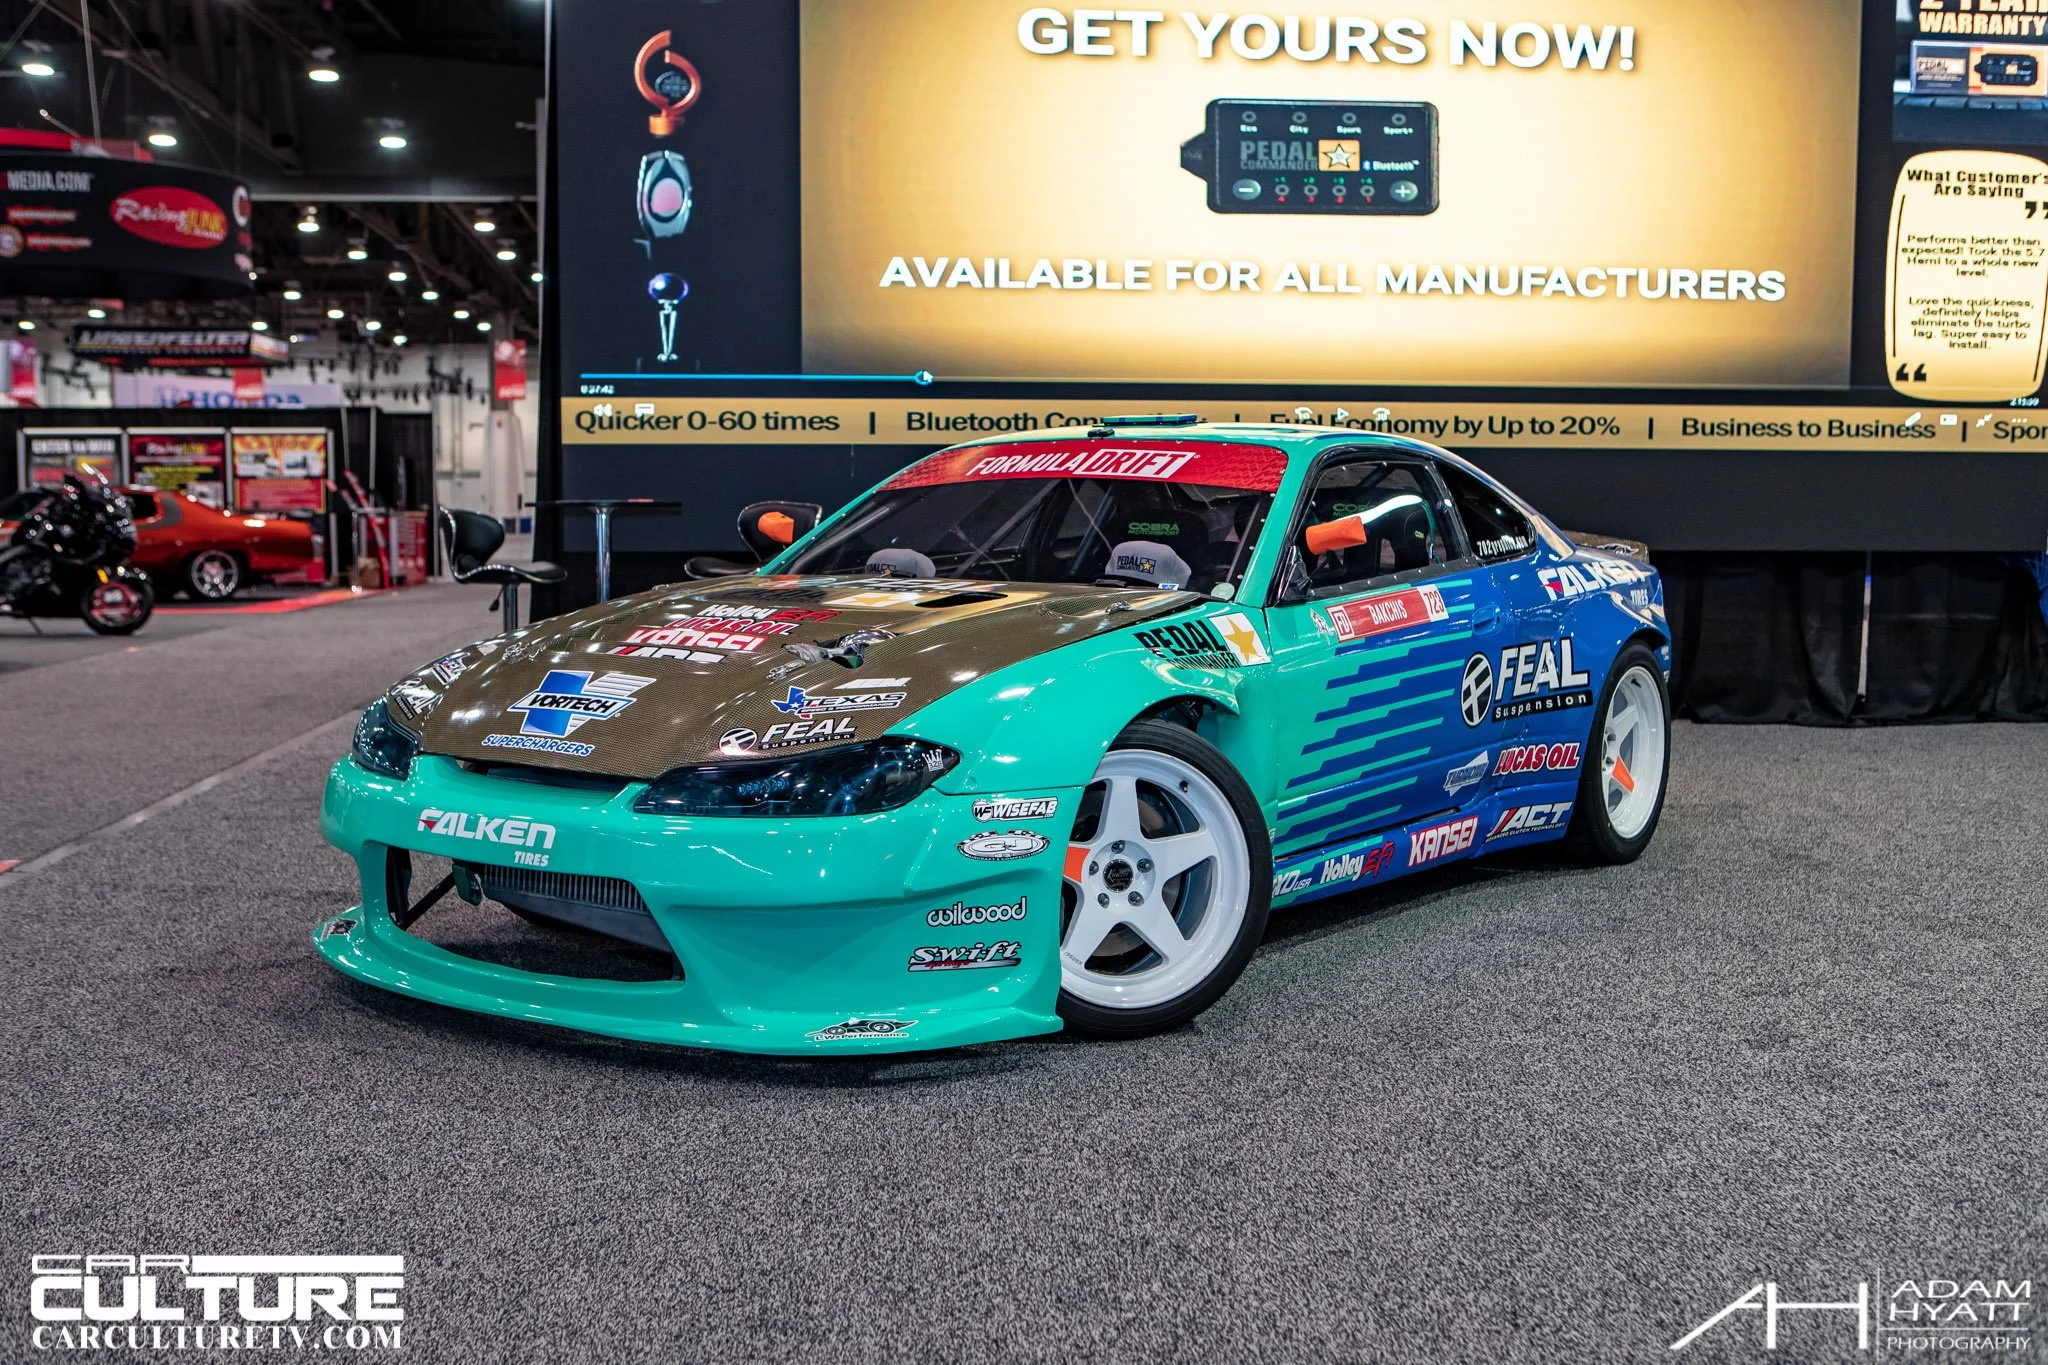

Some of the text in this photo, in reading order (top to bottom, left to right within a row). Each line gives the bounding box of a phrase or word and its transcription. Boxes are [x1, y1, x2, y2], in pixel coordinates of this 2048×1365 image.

[1919, 11, 2048, 36] WARRANTY
[1017, 8, 1637, 71] GET YOURS NOW!
[1289, 125, 1309, 135] City
[1336, 126, 1362, 135] Sport
[1240, 141, 1318, 160] PEDAL
[1240, 160, 1318, 171] COMMANDER
[1907, 170, 1950, 181] What
[1934, 184, 2024, 198] Are Saying
[1907, 235, 2041, 246] Performs better than
[1902, 246, 1963, 256] expected!
[1969, 247, 1997, 255] Took
[2002, 248, 2021, 256] the
[1945, 257, 1957, 266] to
[1973, 258, 2009, 266] whole
[879, 256, 1788, 303] AVAILABLE FOR ALL MANUFACTURERS
[1956, 268, 1989, 277] level.
[1909, 296, 1939, 305] Love
[1943, 297, 1963, 306] the
[1922, 307, 2019, 320] definitely helps
[1911, 318, 2031, 329] eliminate the turbo
[1913, 329, 1936, 339] lag.
[1941, 329, 1977, 340] Super
[1982, 332, 2011, 341] easy
[1949, 340, 1991, 349] install.
[575, 409, 840, 433] Quicker 0-60 times
[906, 411, 1046, 431] Bluetooth
[1453, 414, 1481, 438] by
[1487, 415, 1524, 439] Up
[1530, 417, 1555, 436] to
[1559, 415, 1621, 436] 20%
[1681, 417, 1937, 439] Business to Business
[966, 449, 1193, 478] FORMULA DRIFT
[1128, 522, 1179, 531] COBRA
[1117, 555, 1140, 567] PEDAL
[1630, 589, 1649, 607] TIRES
[697, 604, 777, 620] Holley
[1368, 599, 1408, 625] BAKCHIS
[1133, 620, 1228, 658] PEDAL
[1494, 637, 1590, 701] FEAL
[527, 693, 620, 714] VORTECH
[801, 693, 905, 708] TEXAS
[1494, 693, 1588, 719] Suspension
[762, 716, 857, 742] FEAL
[481, 734, 595, 758] SUPERCHARGERS
[762, 734, 851, 750] Suspension
[1492, 744, 1548, 776] LUCAS
[1546, 742, 1581, 771] OIL
[992, 800, 1058, 818] WISEFAB
[1499, 802, 1573, 832] ACT
[417, 808, 557, 850] FALKEN
[1407, 815, 1479, 868] KANSEI
[514, 851, 550, 867] TIRES
[1320, 853, 1365, 884] Holley
[926, 896, 1028, 927] wilwood
[908, 941, 1022, 965] Swift
